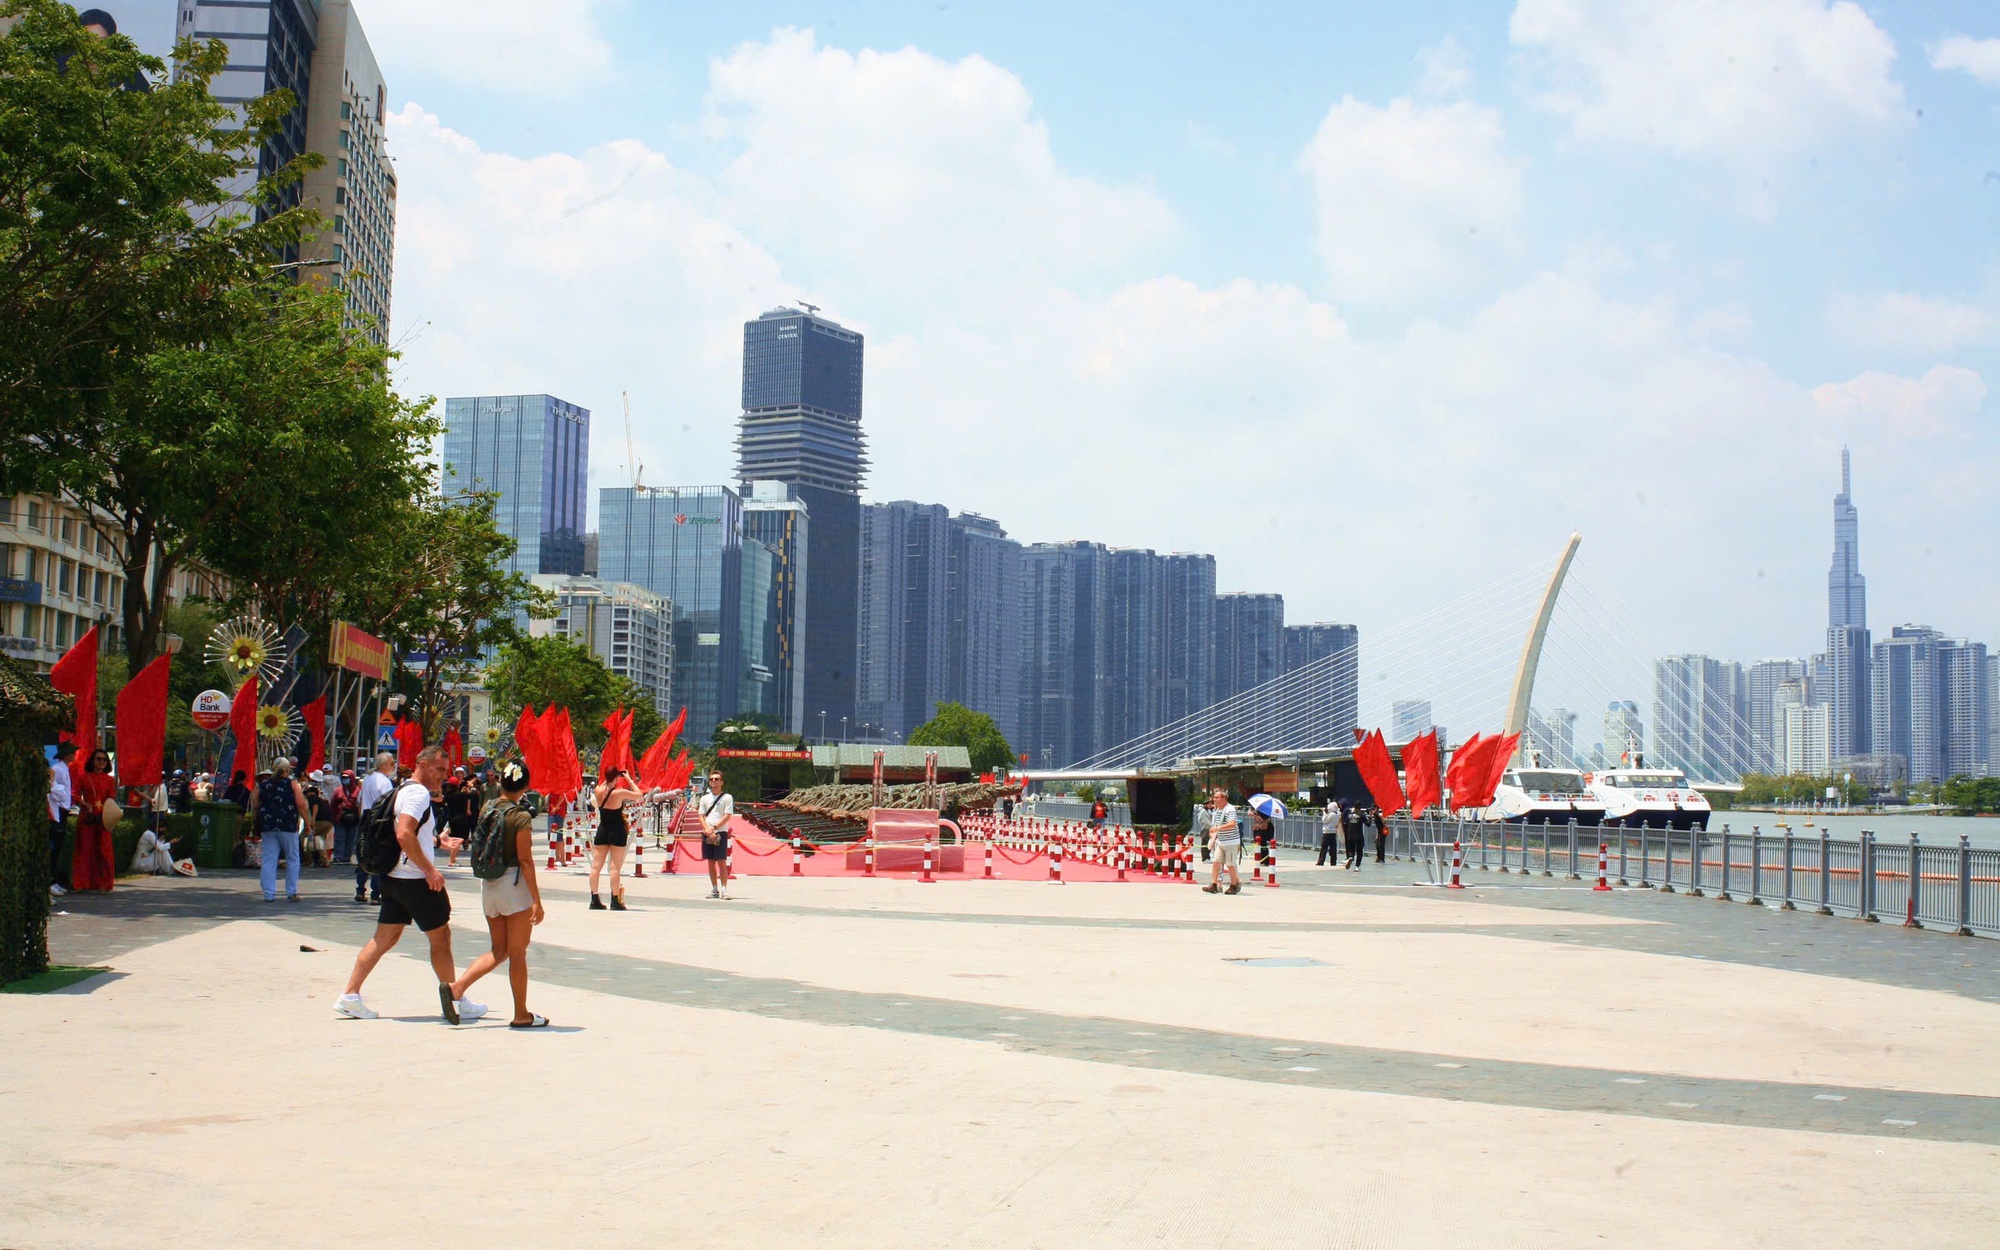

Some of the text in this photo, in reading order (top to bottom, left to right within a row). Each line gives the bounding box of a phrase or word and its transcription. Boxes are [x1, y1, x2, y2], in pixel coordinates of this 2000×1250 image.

[552, 406, 565, 417] THE
[688, 517, 721, 525] VPBank
[201, 695, 213, 703] HD
[200, 703, 220, 711] Bank
